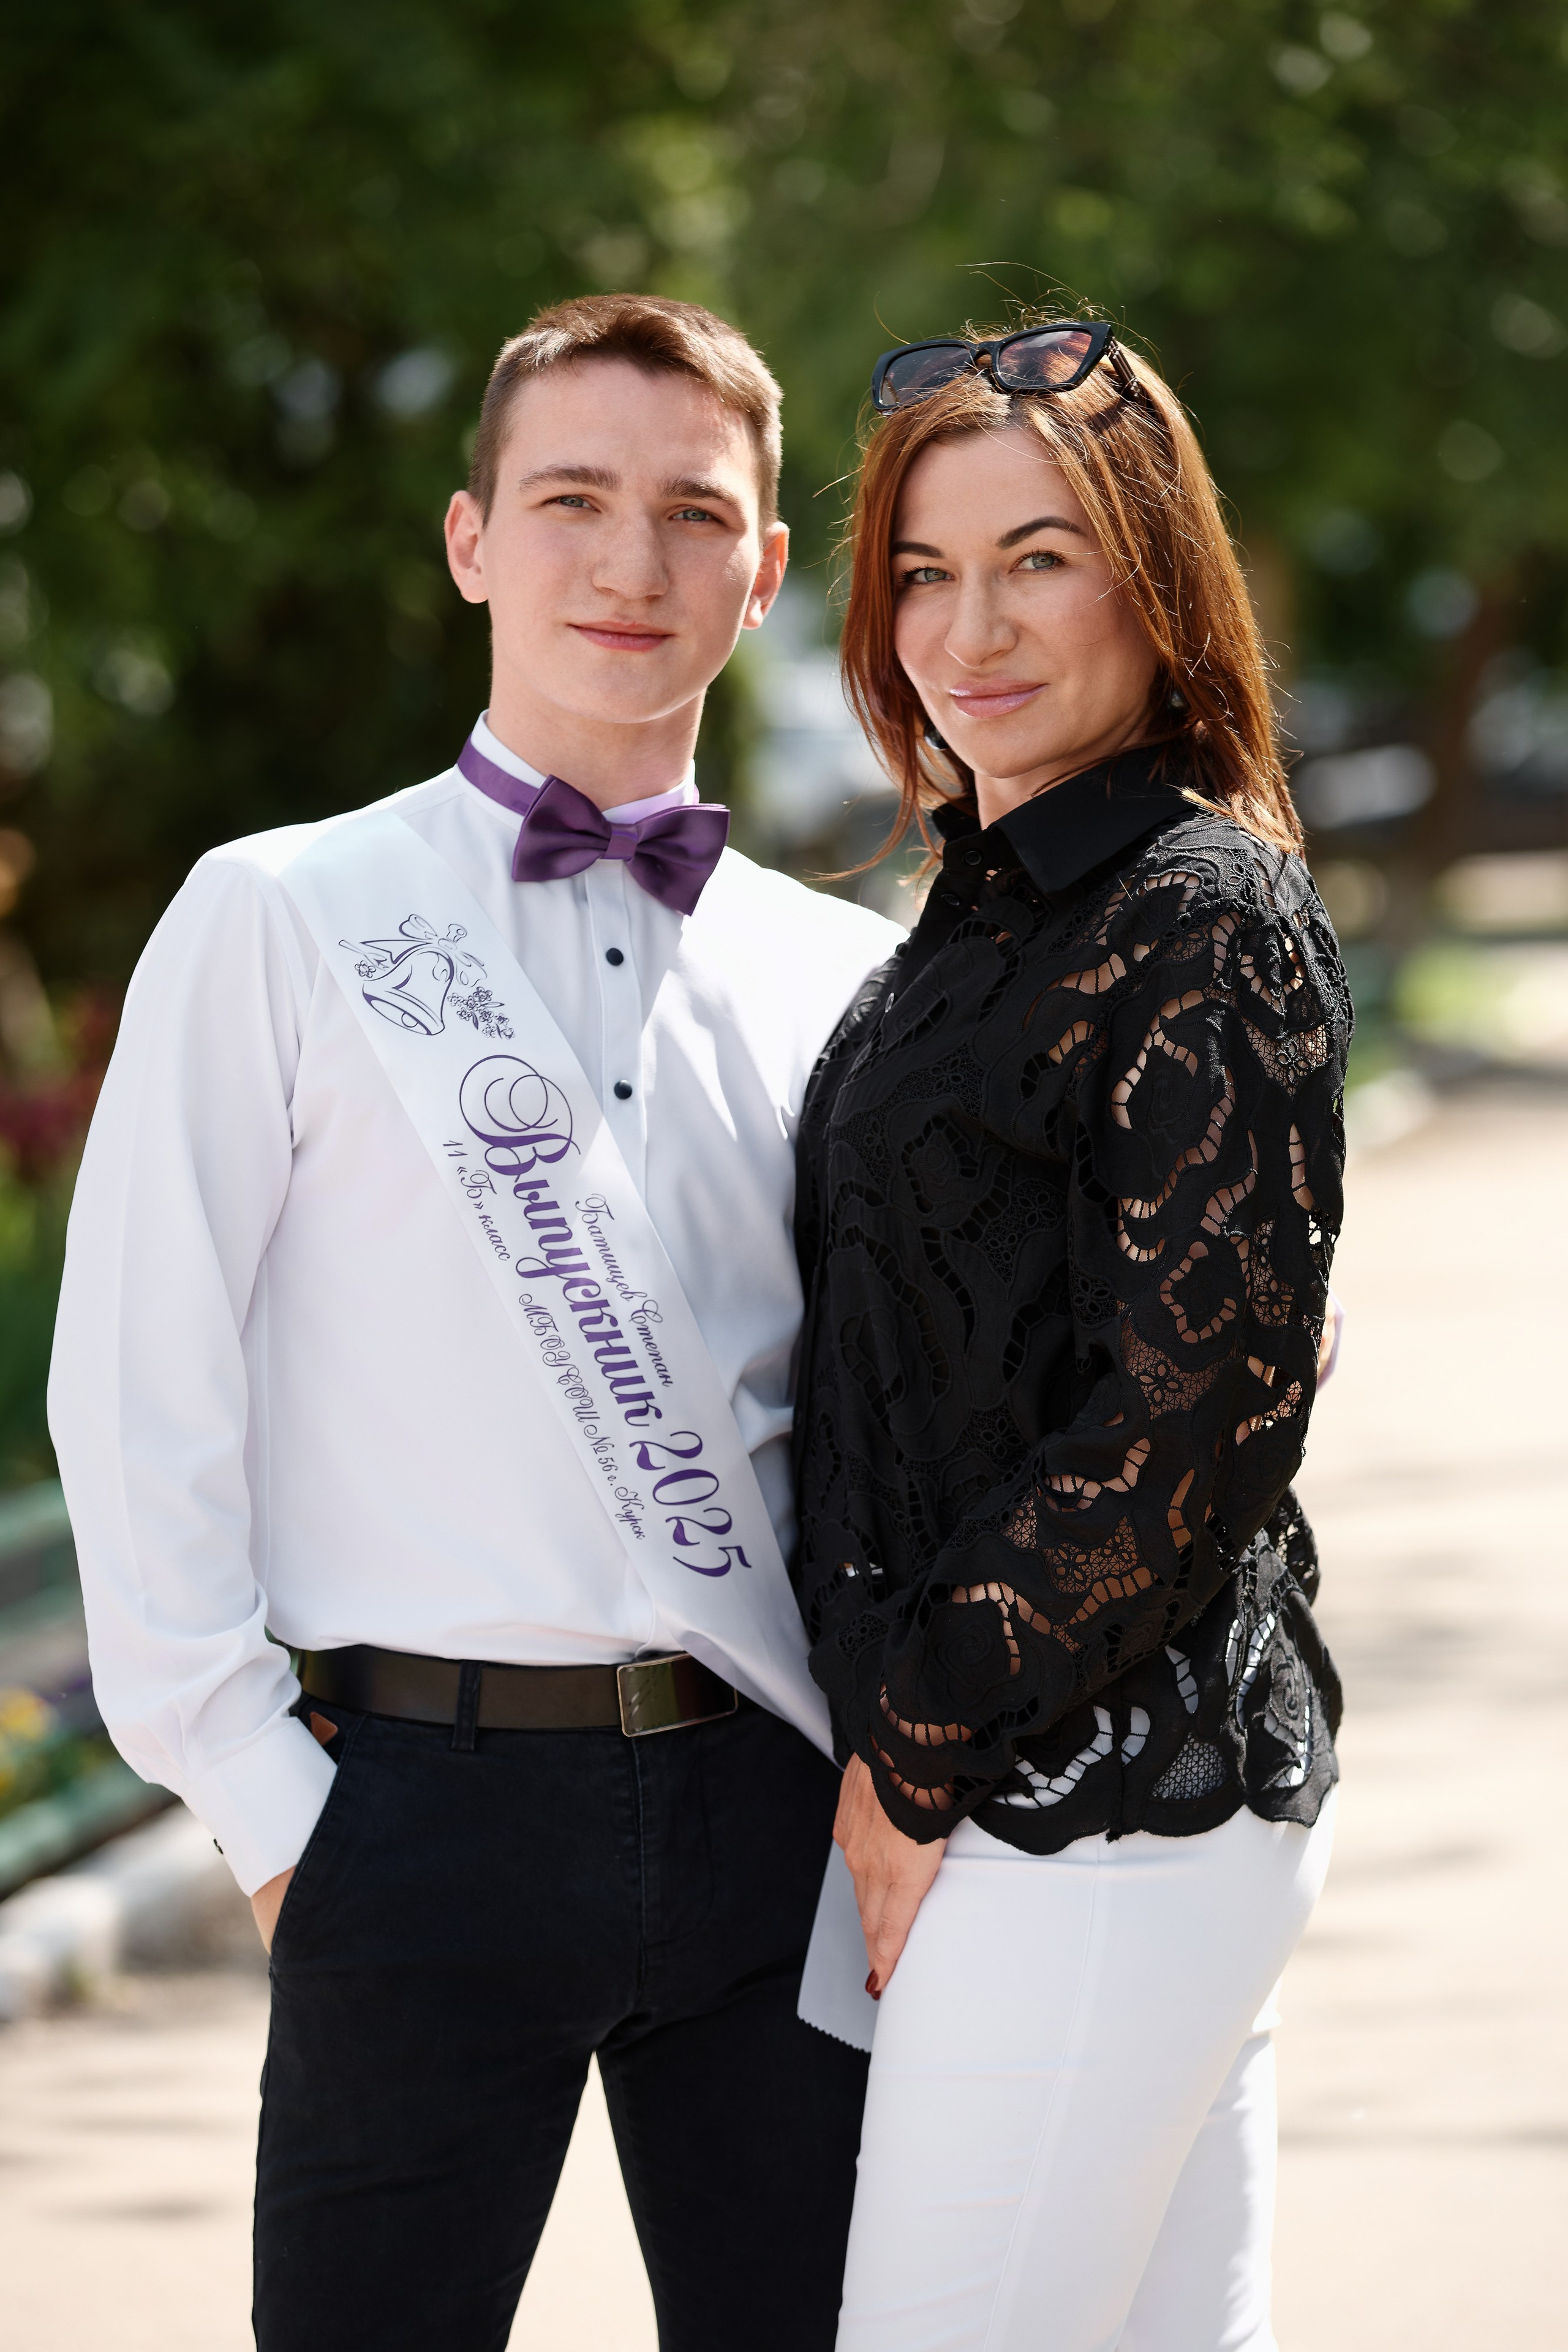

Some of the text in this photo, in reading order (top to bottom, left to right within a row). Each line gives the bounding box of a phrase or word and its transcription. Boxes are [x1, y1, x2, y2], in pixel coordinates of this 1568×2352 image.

[442, 1140, 468, 1157] 11
[478, 1215, 510, 1261] класс
[458, 1054, 752, 1577] Выпускник 2025
[575, 1193, 673, 1387] Батищев Степан
[598, 1457, 618, 1472] 56
[614, 1487, 645, 1540] Курск
